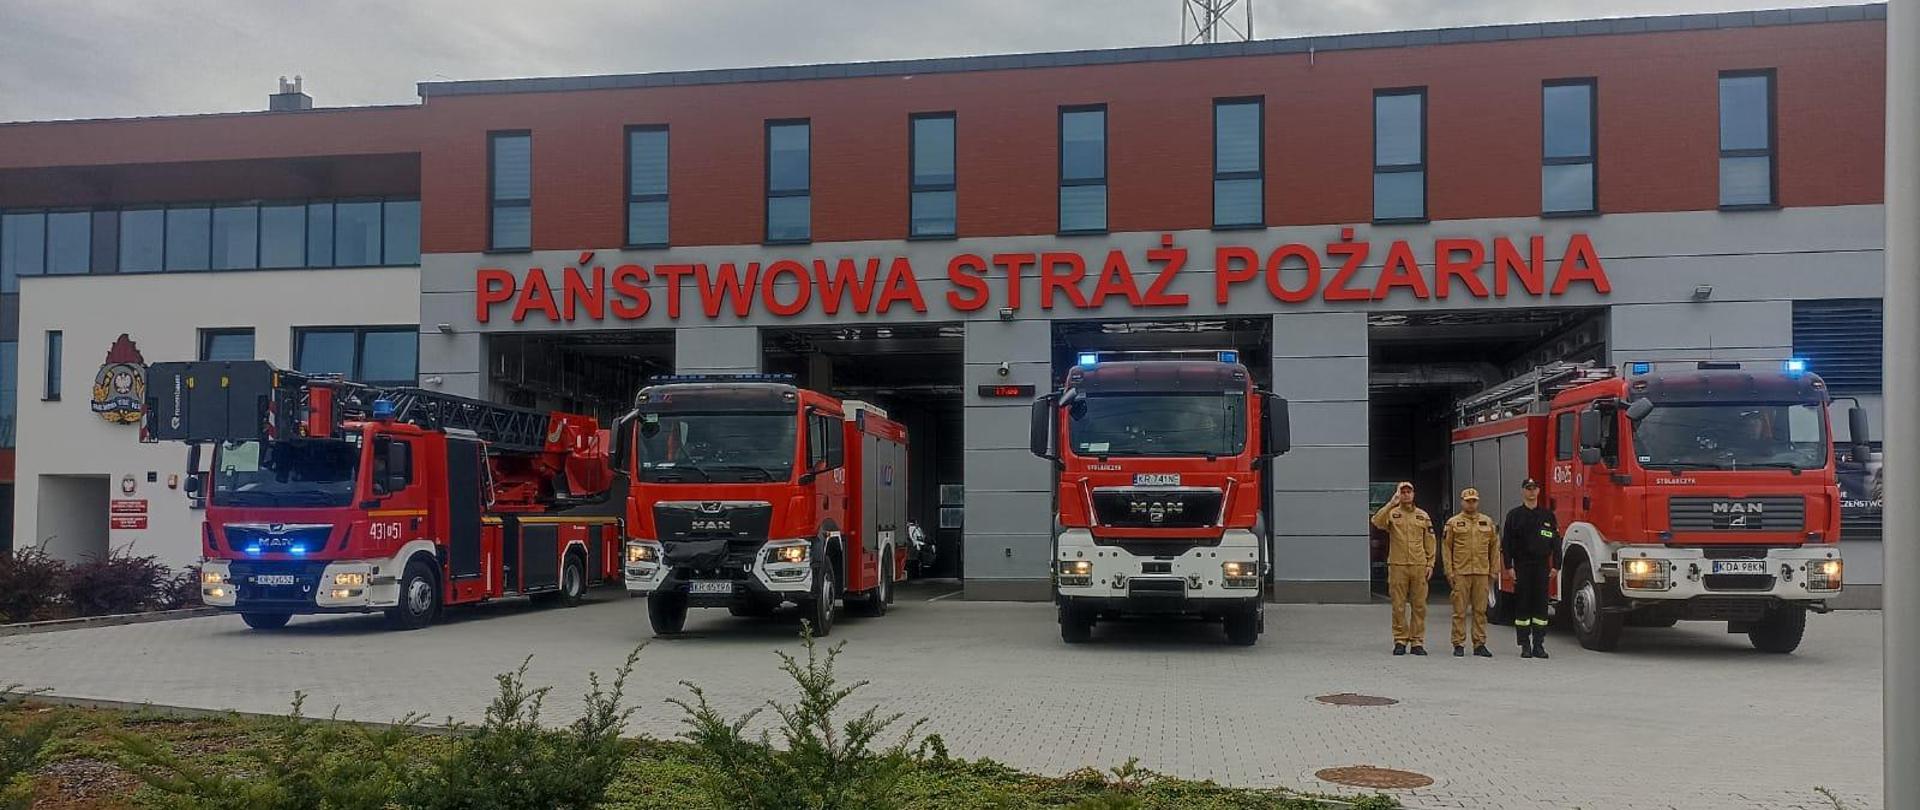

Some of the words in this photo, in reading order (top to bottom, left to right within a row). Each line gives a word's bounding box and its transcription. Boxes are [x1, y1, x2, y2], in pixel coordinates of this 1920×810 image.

[476, 252, 927, 322] PAŃSTWOWA
[946, 234, 1189, 312] STRAŻ
[1216, 228, 1611, 304] POŻARNA
[1130, 502, 1183, 512] MAN
[1713, 503, 1762, 513] MAN
[692, 521, 731, 529] MAN
[370, 522, 386, 540] 431
[259, 538, 294, 546] MAN
[1719, 562, 1738, 571] KDA
